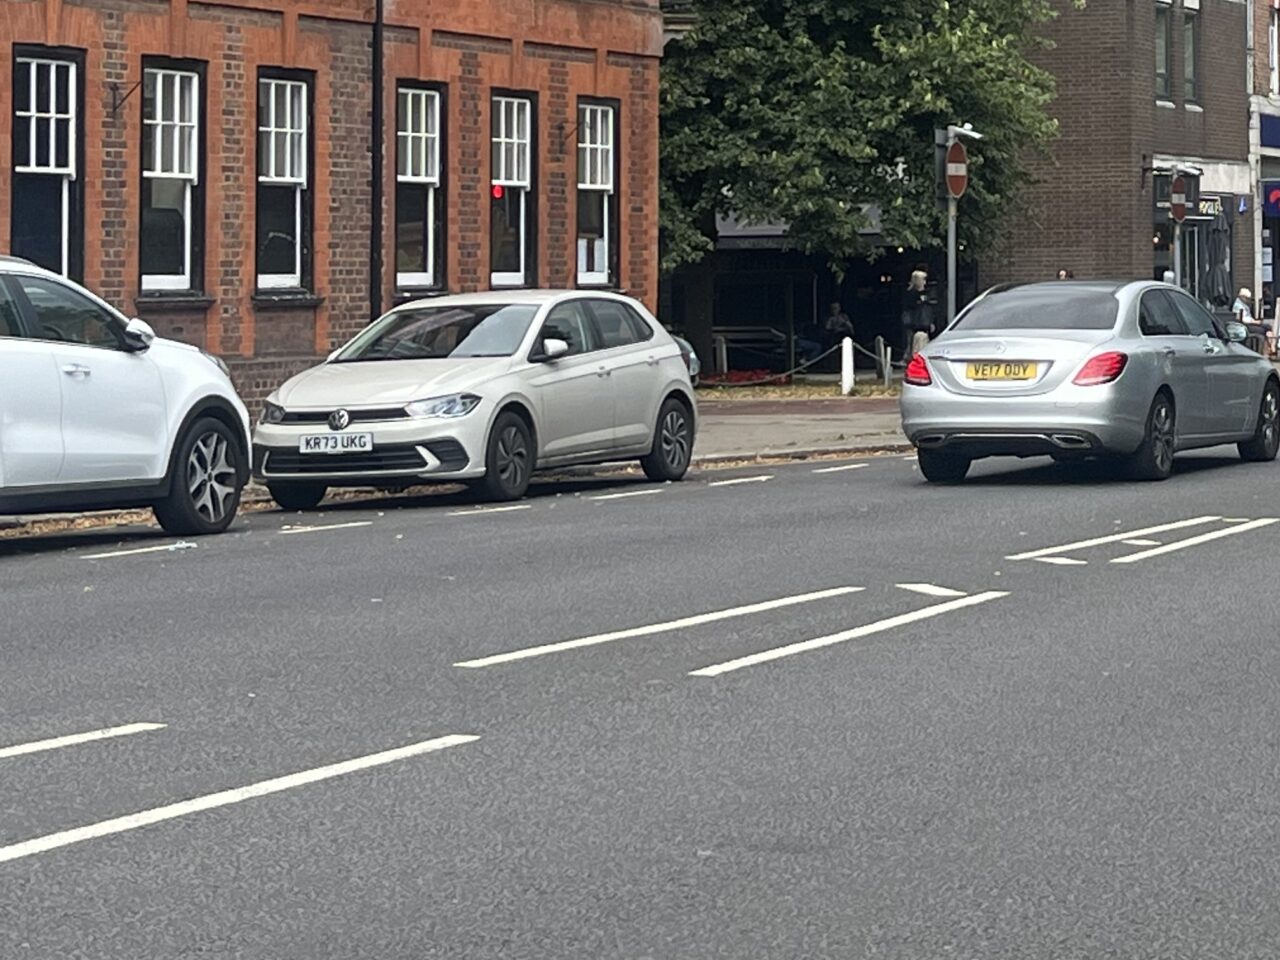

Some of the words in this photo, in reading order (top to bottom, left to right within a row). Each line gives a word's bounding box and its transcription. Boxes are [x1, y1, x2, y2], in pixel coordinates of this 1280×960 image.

[974, 363, 1001, 376] VE17
[305, 436, 338, 450] KR73
[341, 435, 367, 449] UKG
